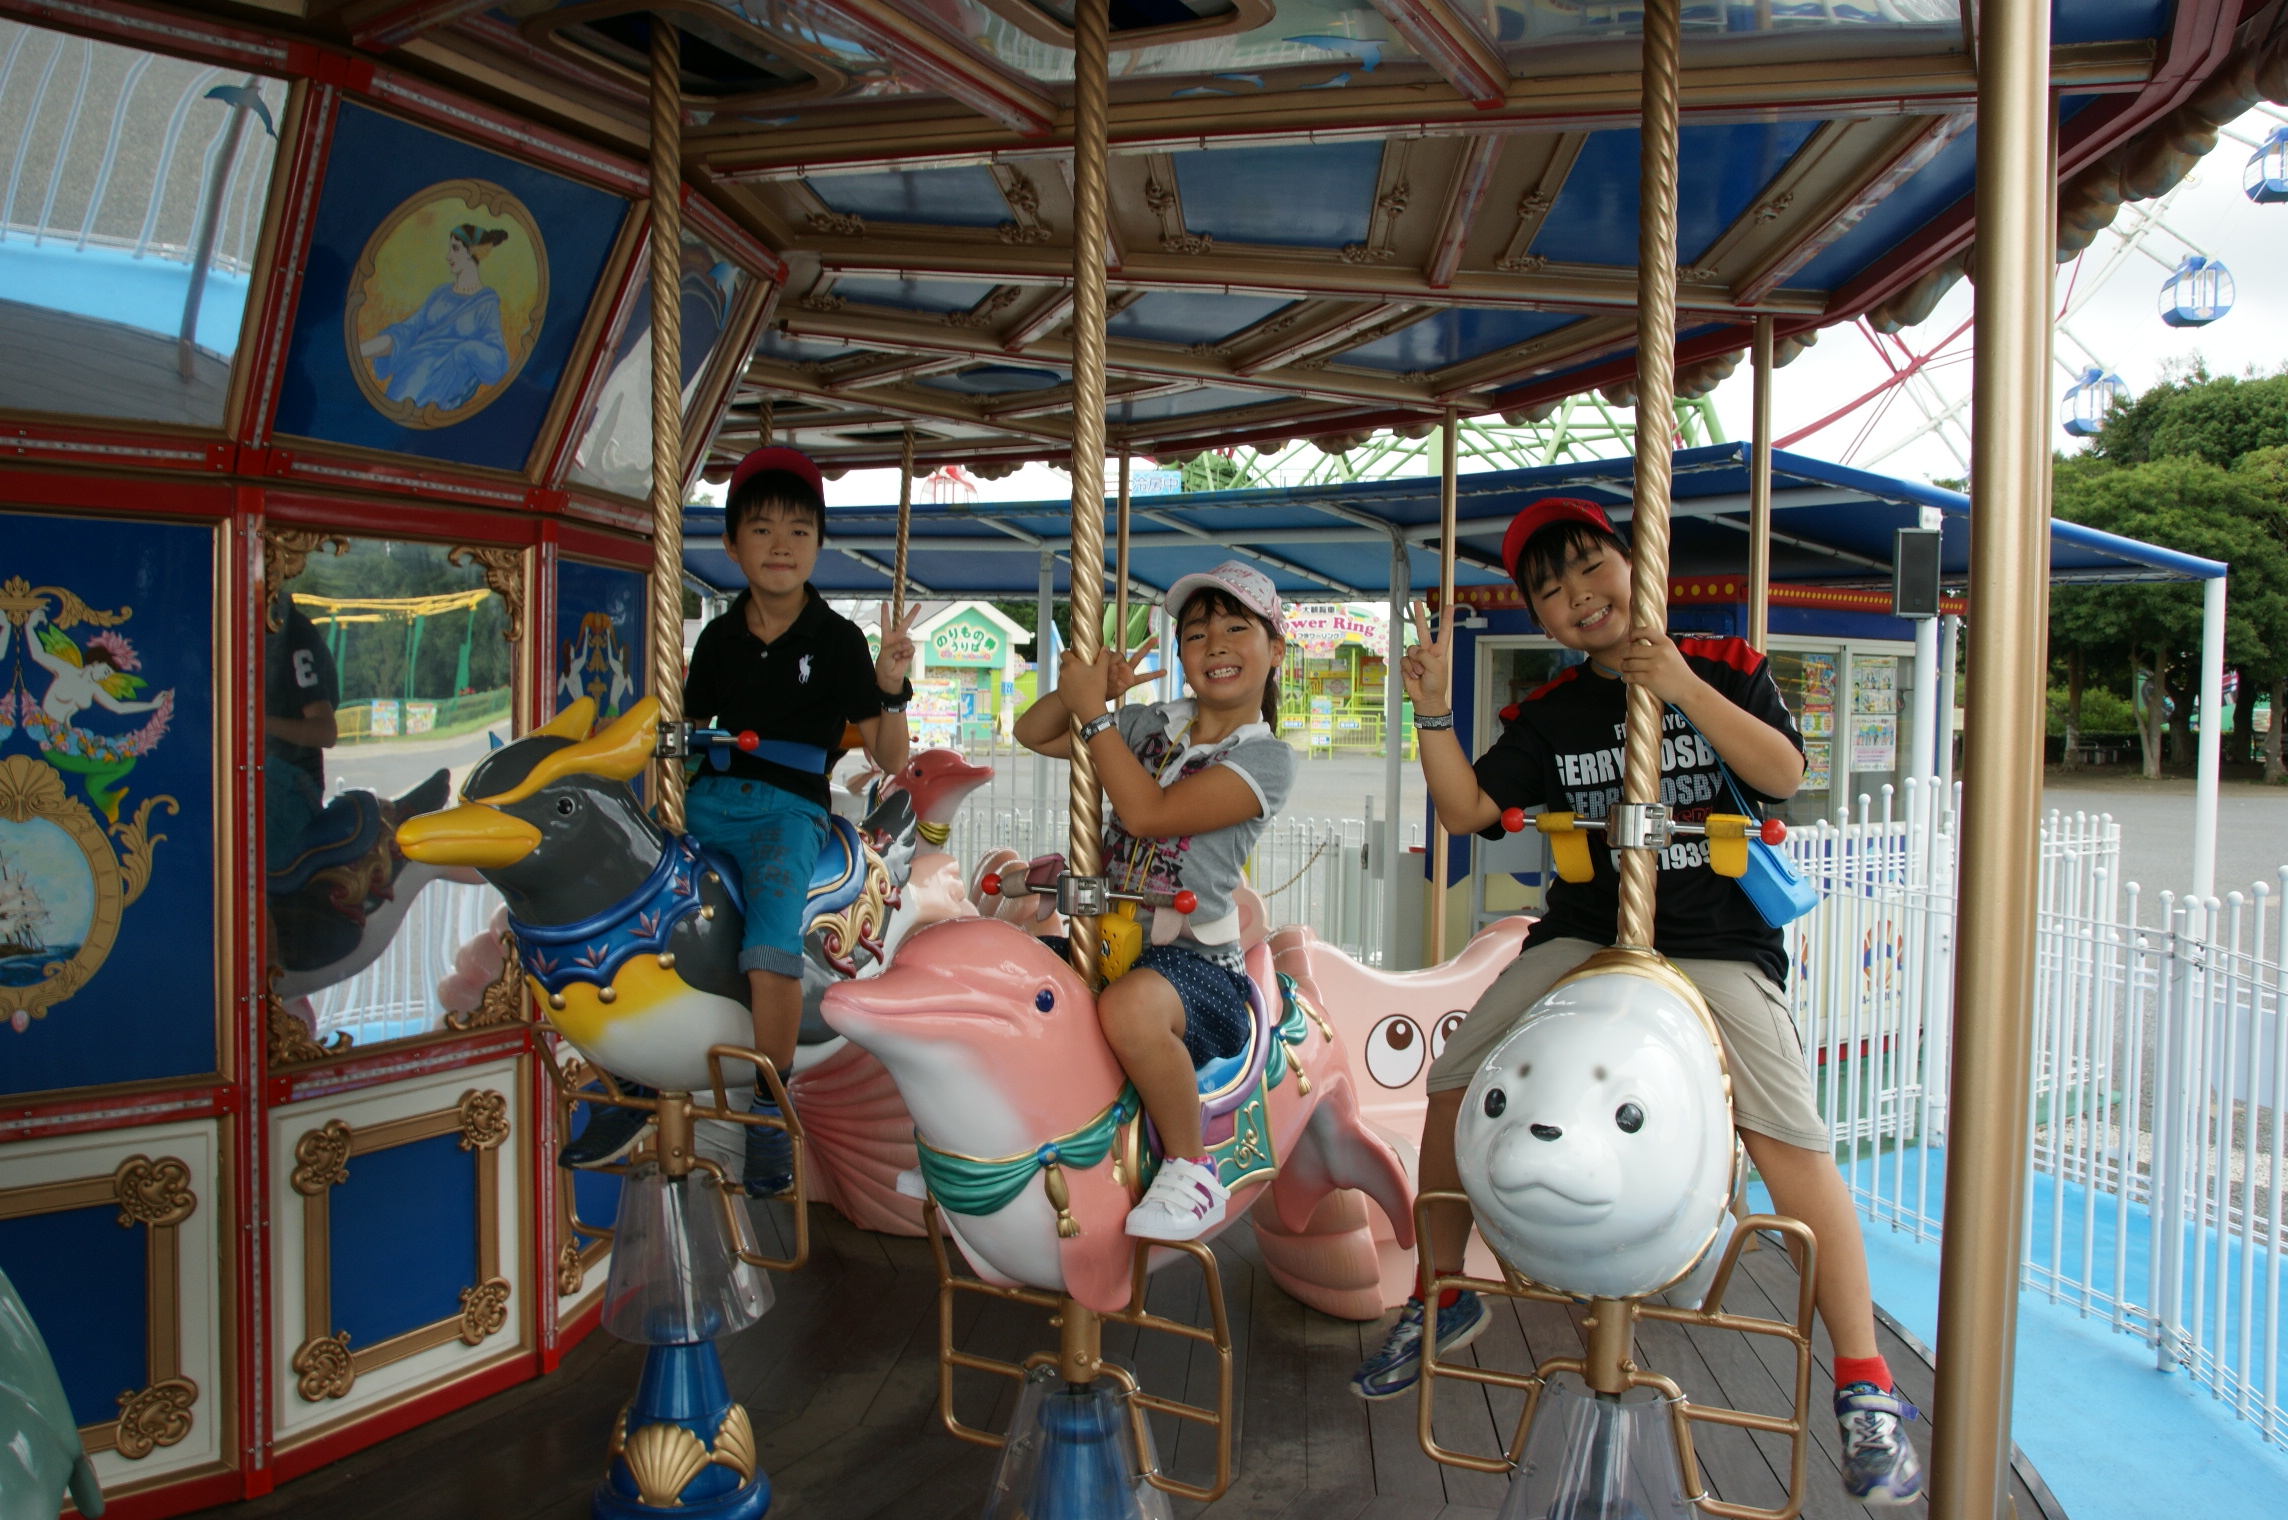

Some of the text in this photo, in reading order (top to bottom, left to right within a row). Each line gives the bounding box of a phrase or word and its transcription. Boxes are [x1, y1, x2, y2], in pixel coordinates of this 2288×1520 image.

[1132, 475, 1179, 493] 冷房中
[1286, 616, 1376, 637] wer Ring
[951, 640, 981, 652] うりば
[1660, 734, 1720, 772] OSB
[1565, 770, 1723, 819] ERR OSBY
[1659, 838, 1710, 871] 1939
